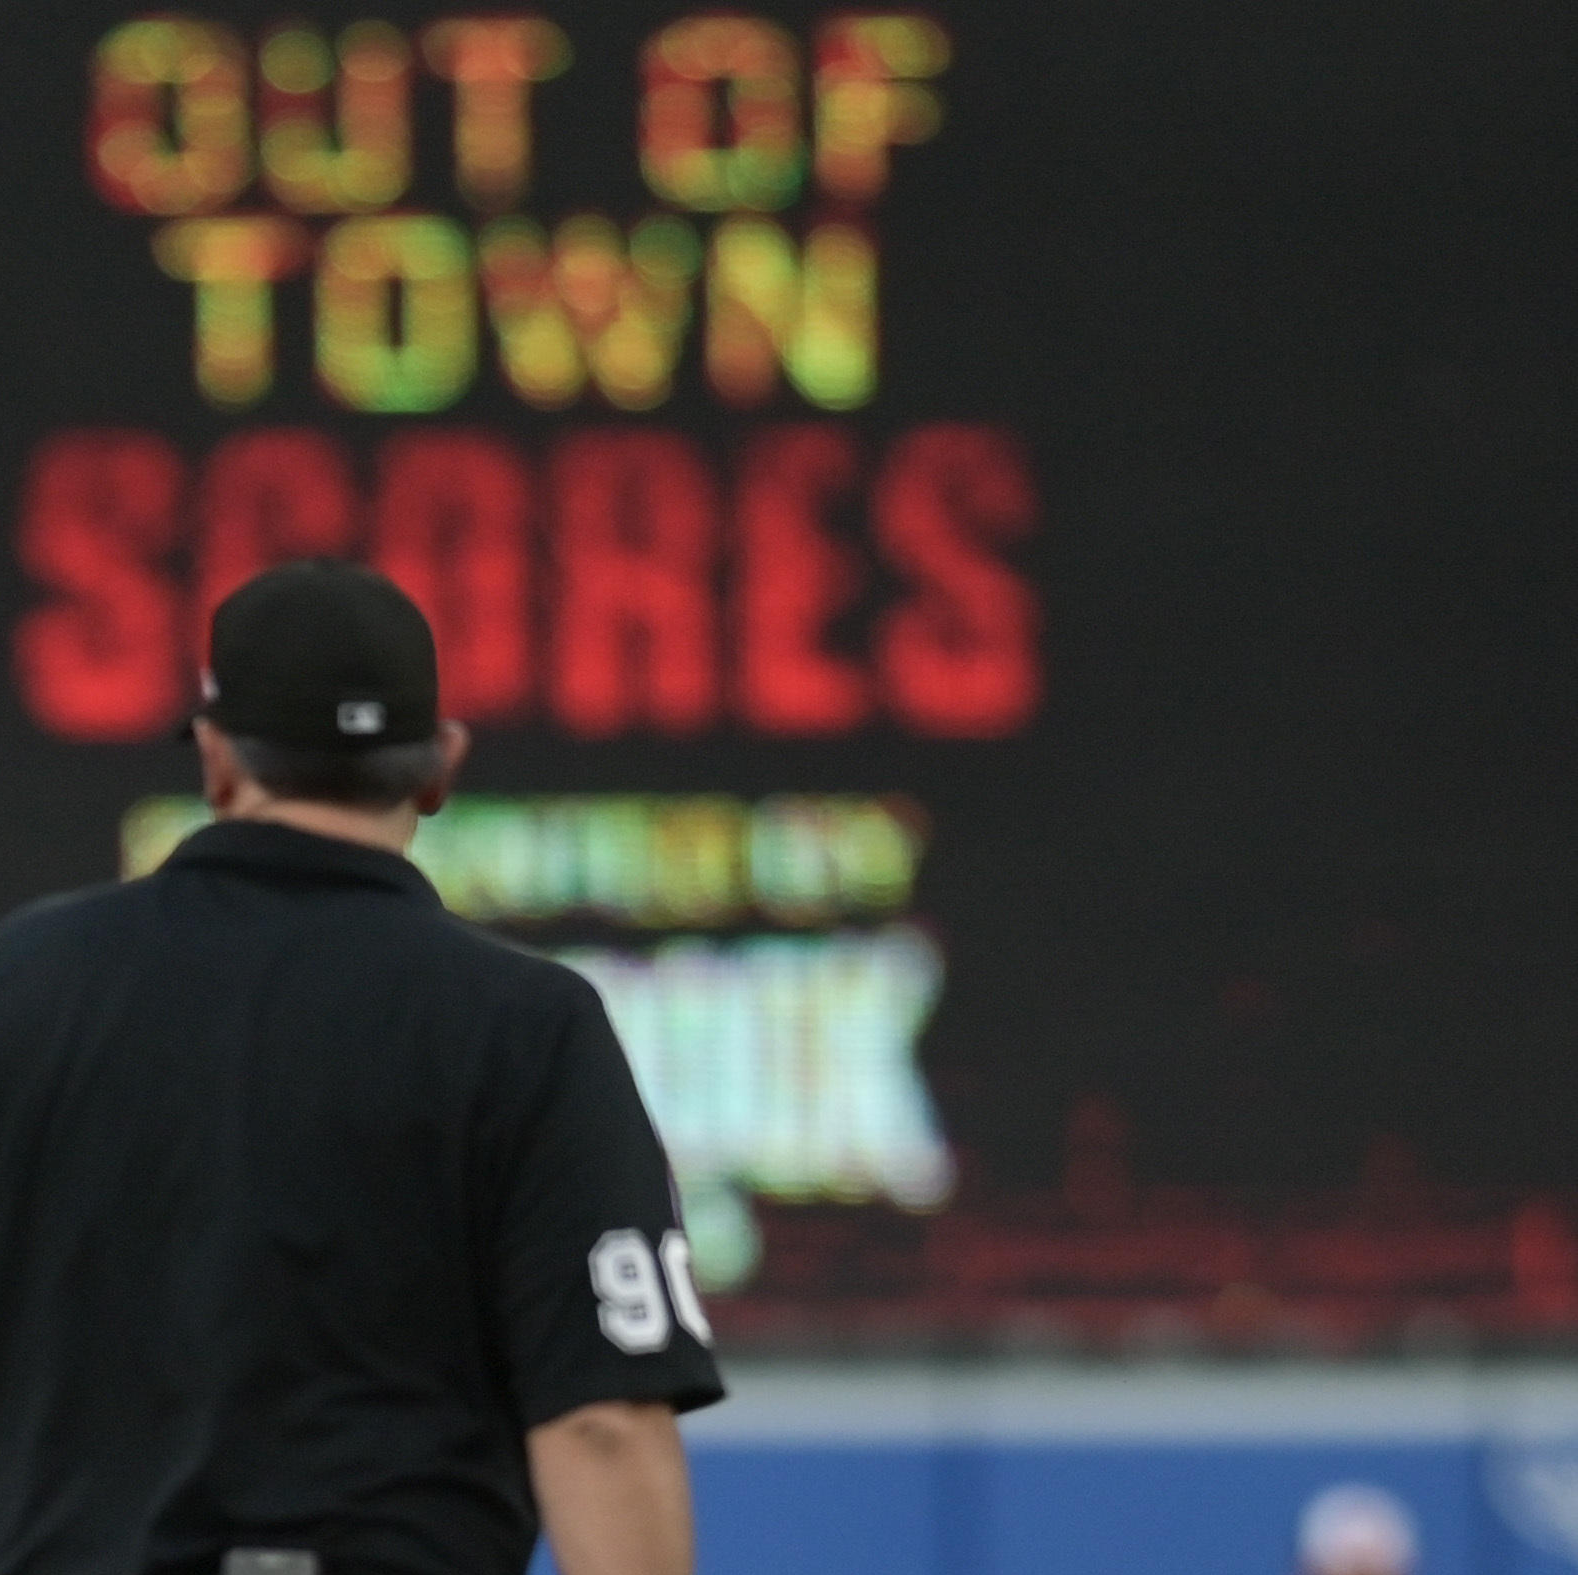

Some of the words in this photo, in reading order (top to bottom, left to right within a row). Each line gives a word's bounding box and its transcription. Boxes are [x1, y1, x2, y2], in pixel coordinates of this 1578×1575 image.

[88, 16, 573, 212] OUT
[638, 14, 951, 212] OF
[151, 214, 881, 412] TOWN
